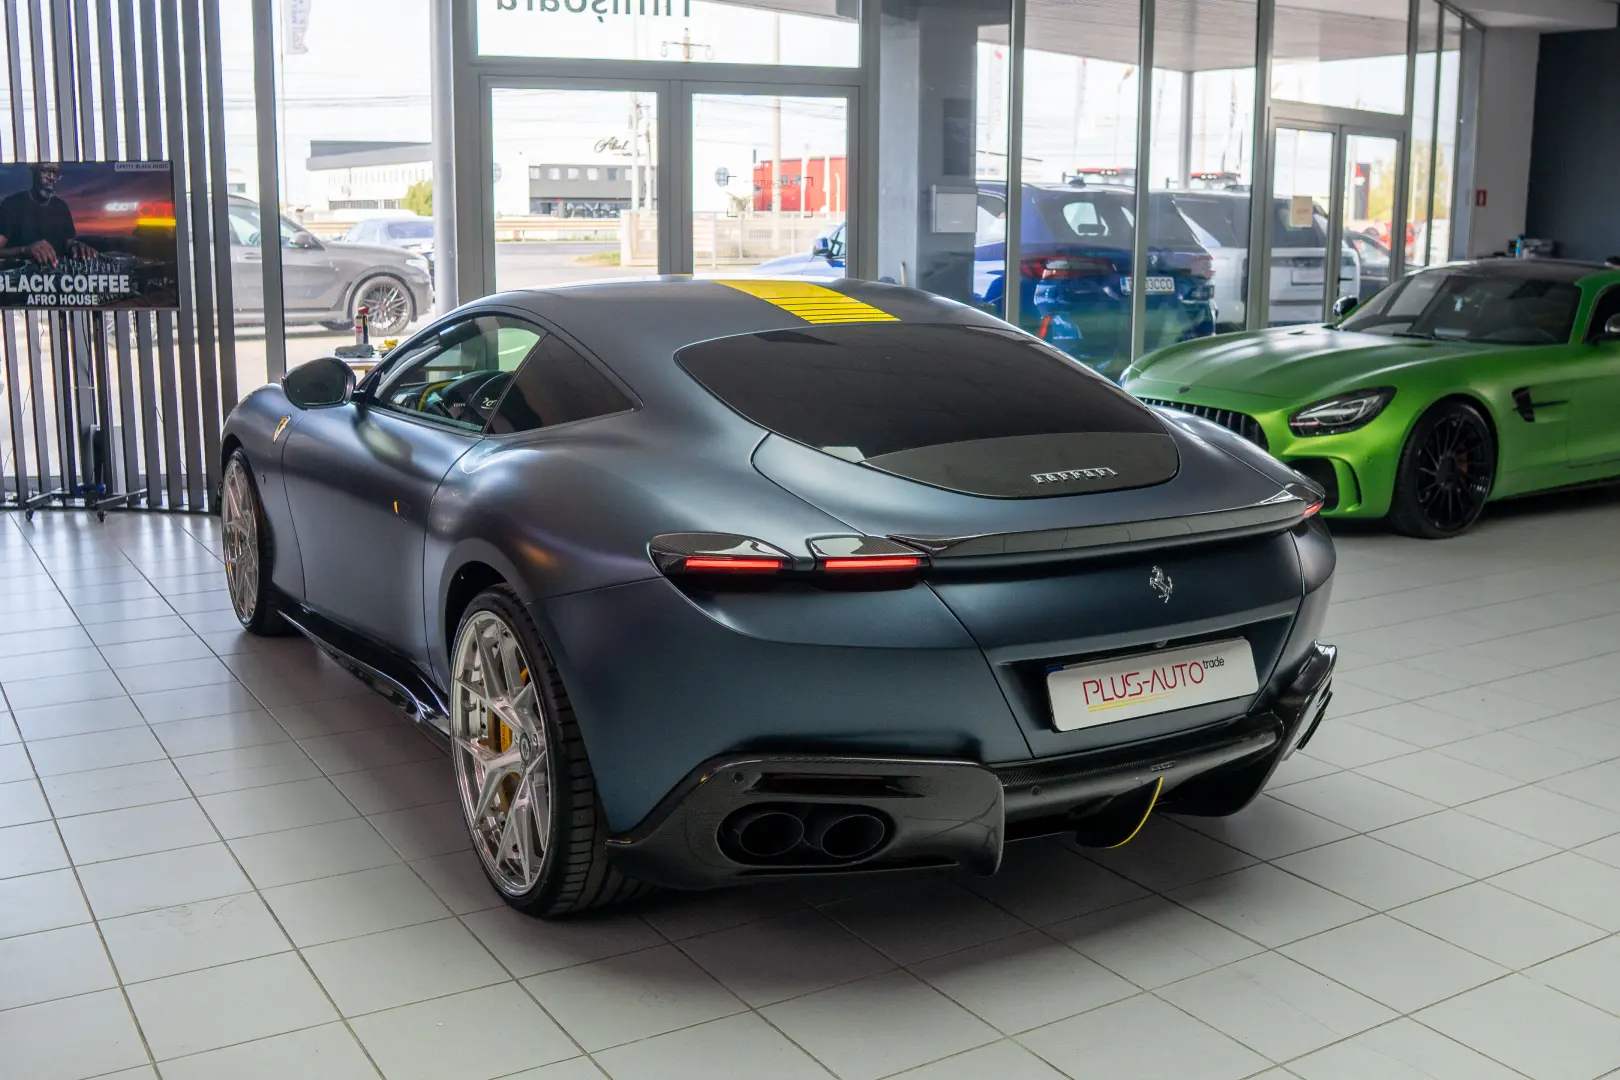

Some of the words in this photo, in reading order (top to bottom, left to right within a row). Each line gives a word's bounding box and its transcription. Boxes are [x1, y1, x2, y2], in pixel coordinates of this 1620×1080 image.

[60, 274, 130, 293] COFFEE
[27, 294, 57, 306] AFRO
[59, 294, 99, 306] HOUSE
[1082, 661, 1204, 705] PLUS-AUTO
[1202, 656, 1225, 670] trade
